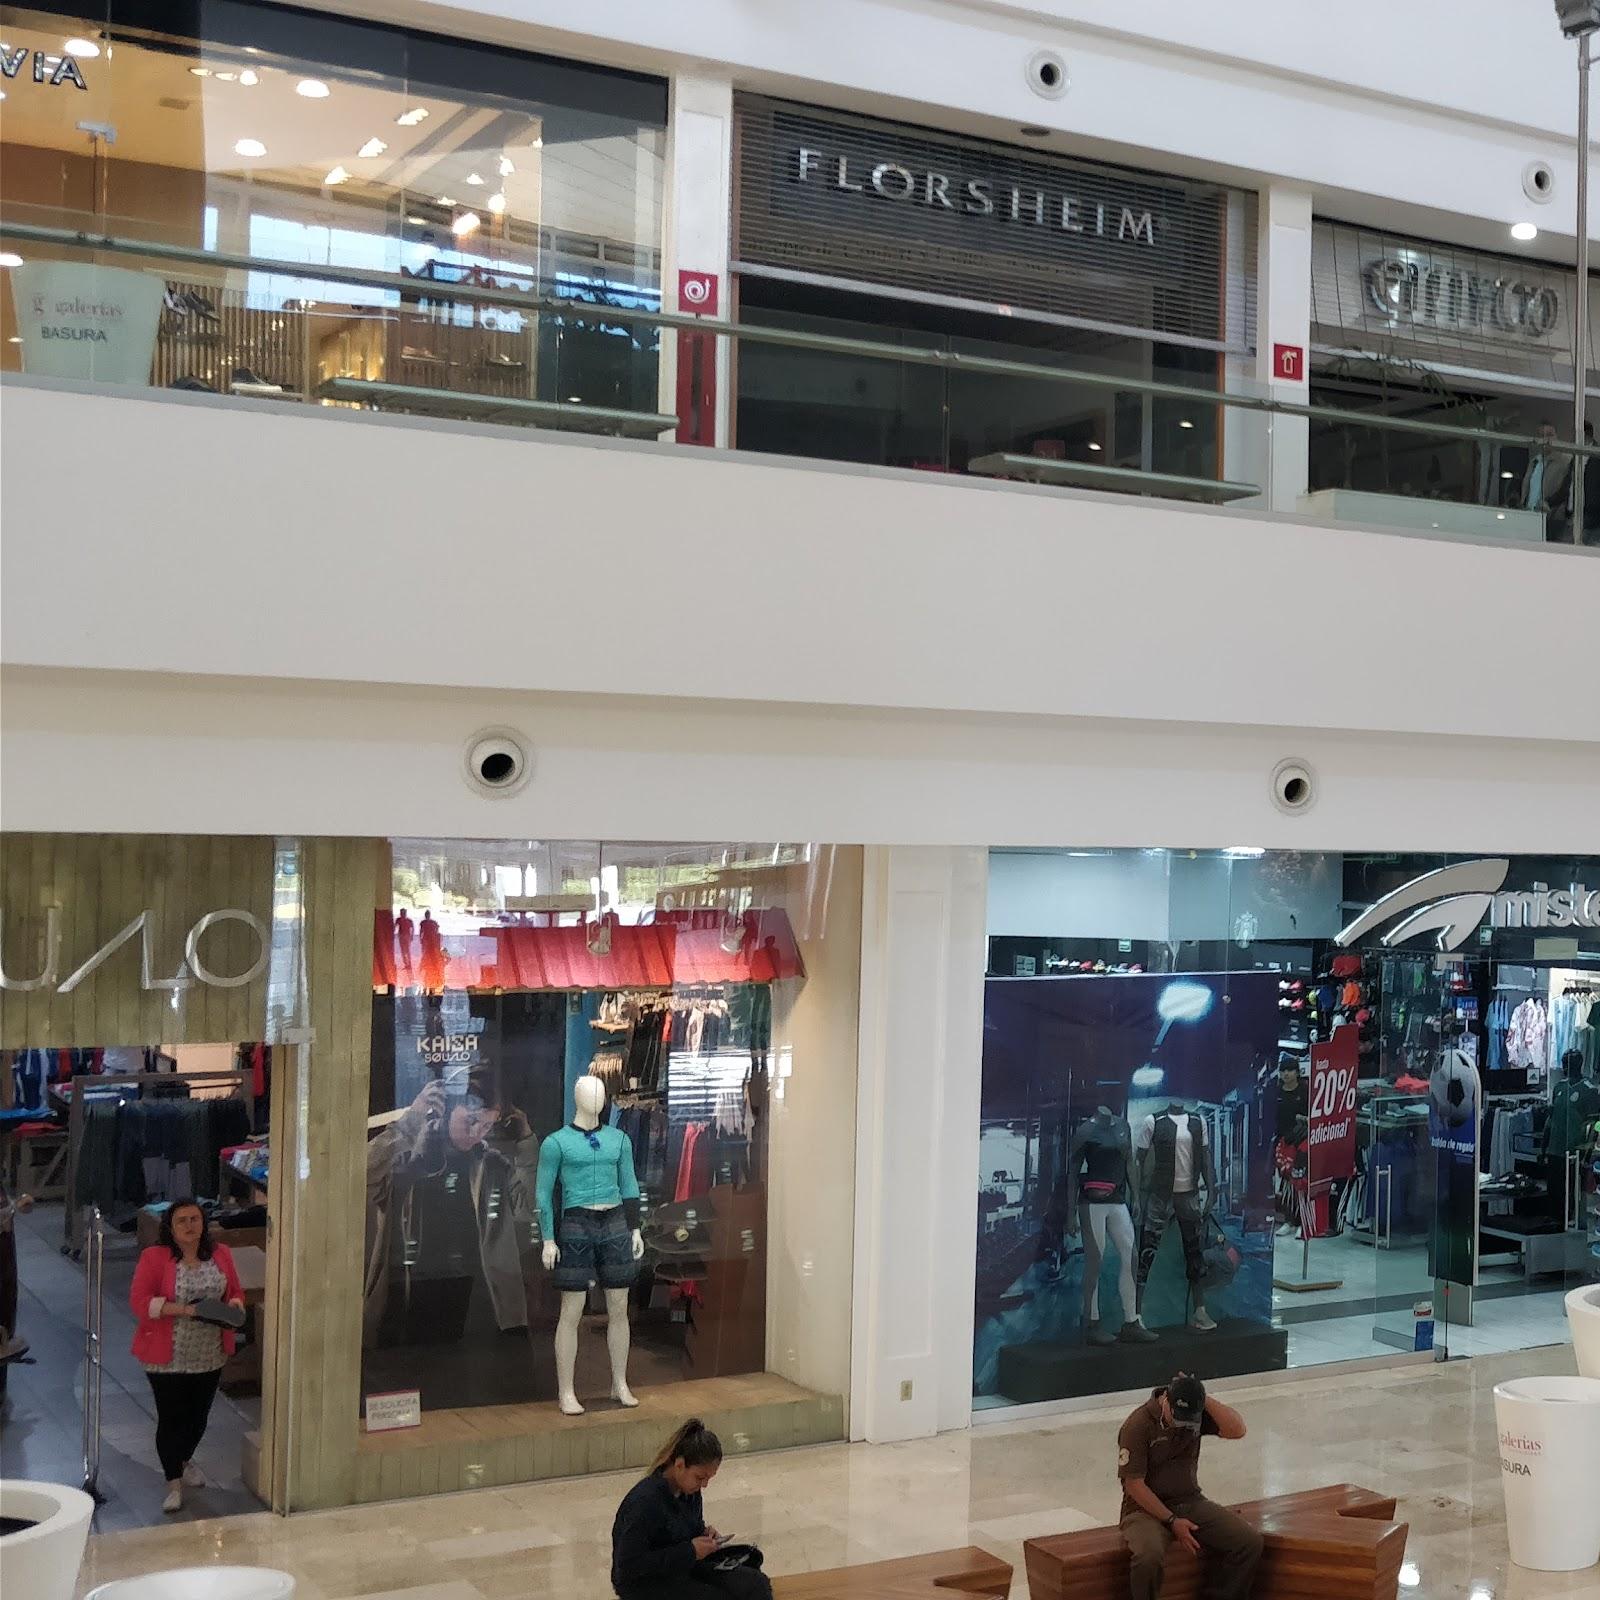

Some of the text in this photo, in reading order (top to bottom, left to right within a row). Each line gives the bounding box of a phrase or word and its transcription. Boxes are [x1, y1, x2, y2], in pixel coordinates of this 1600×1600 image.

[794, 147, 1156, 247] FLORSHEIM
[41, 326, 108, 342] BASURA
[1310, 1066, 1356, 1119] 20%
[1502, 1458, 1532, 1477] SURA
